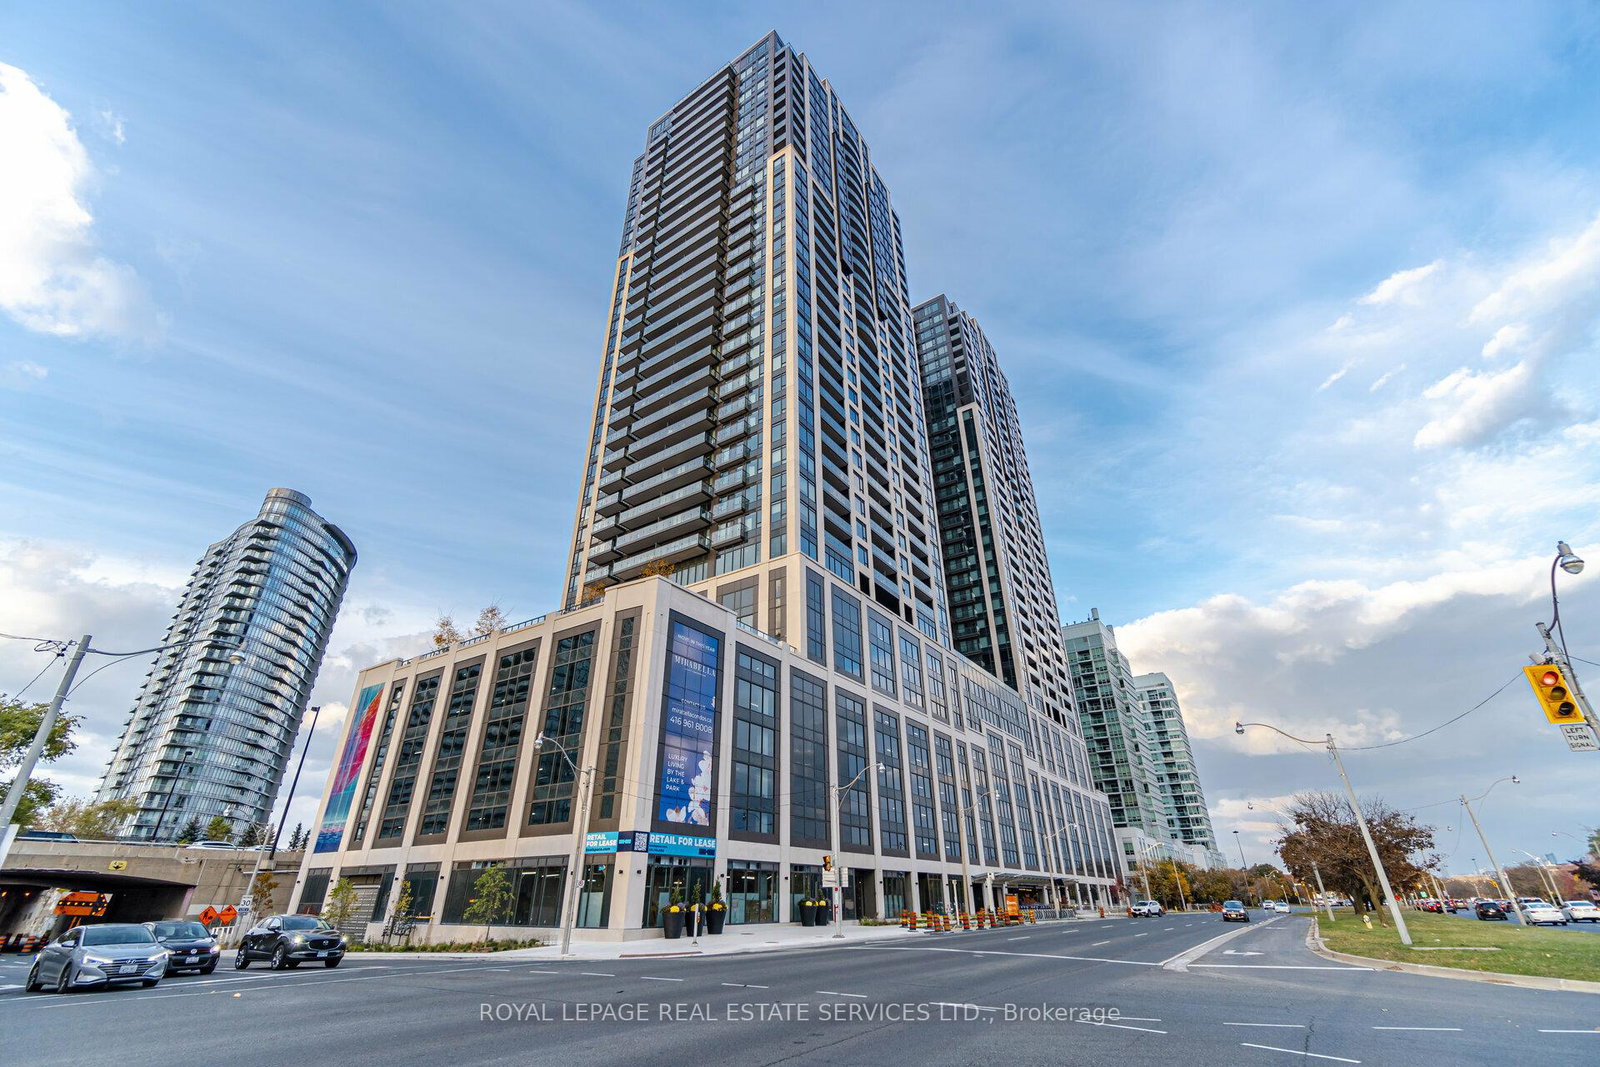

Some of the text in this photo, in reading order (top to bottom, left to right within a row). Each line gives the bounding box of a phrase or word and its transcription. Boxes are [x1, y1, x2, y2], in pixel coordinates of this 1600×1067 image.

[674, 655, 716, 677] MIRABELLA
[670, 715, 682, 726] 416
[683, 719, 694, 729] 961
[668, 753, 688, 762] LUXURY
[667, 761, 685, 769] LIVING
[675, 770, 685, 778] THE
[586, 840, 598, 848] FOR
[599, 839, 617, 847] LEASE
[650, 834, 716, 848] RETAIL FOR LEASE
